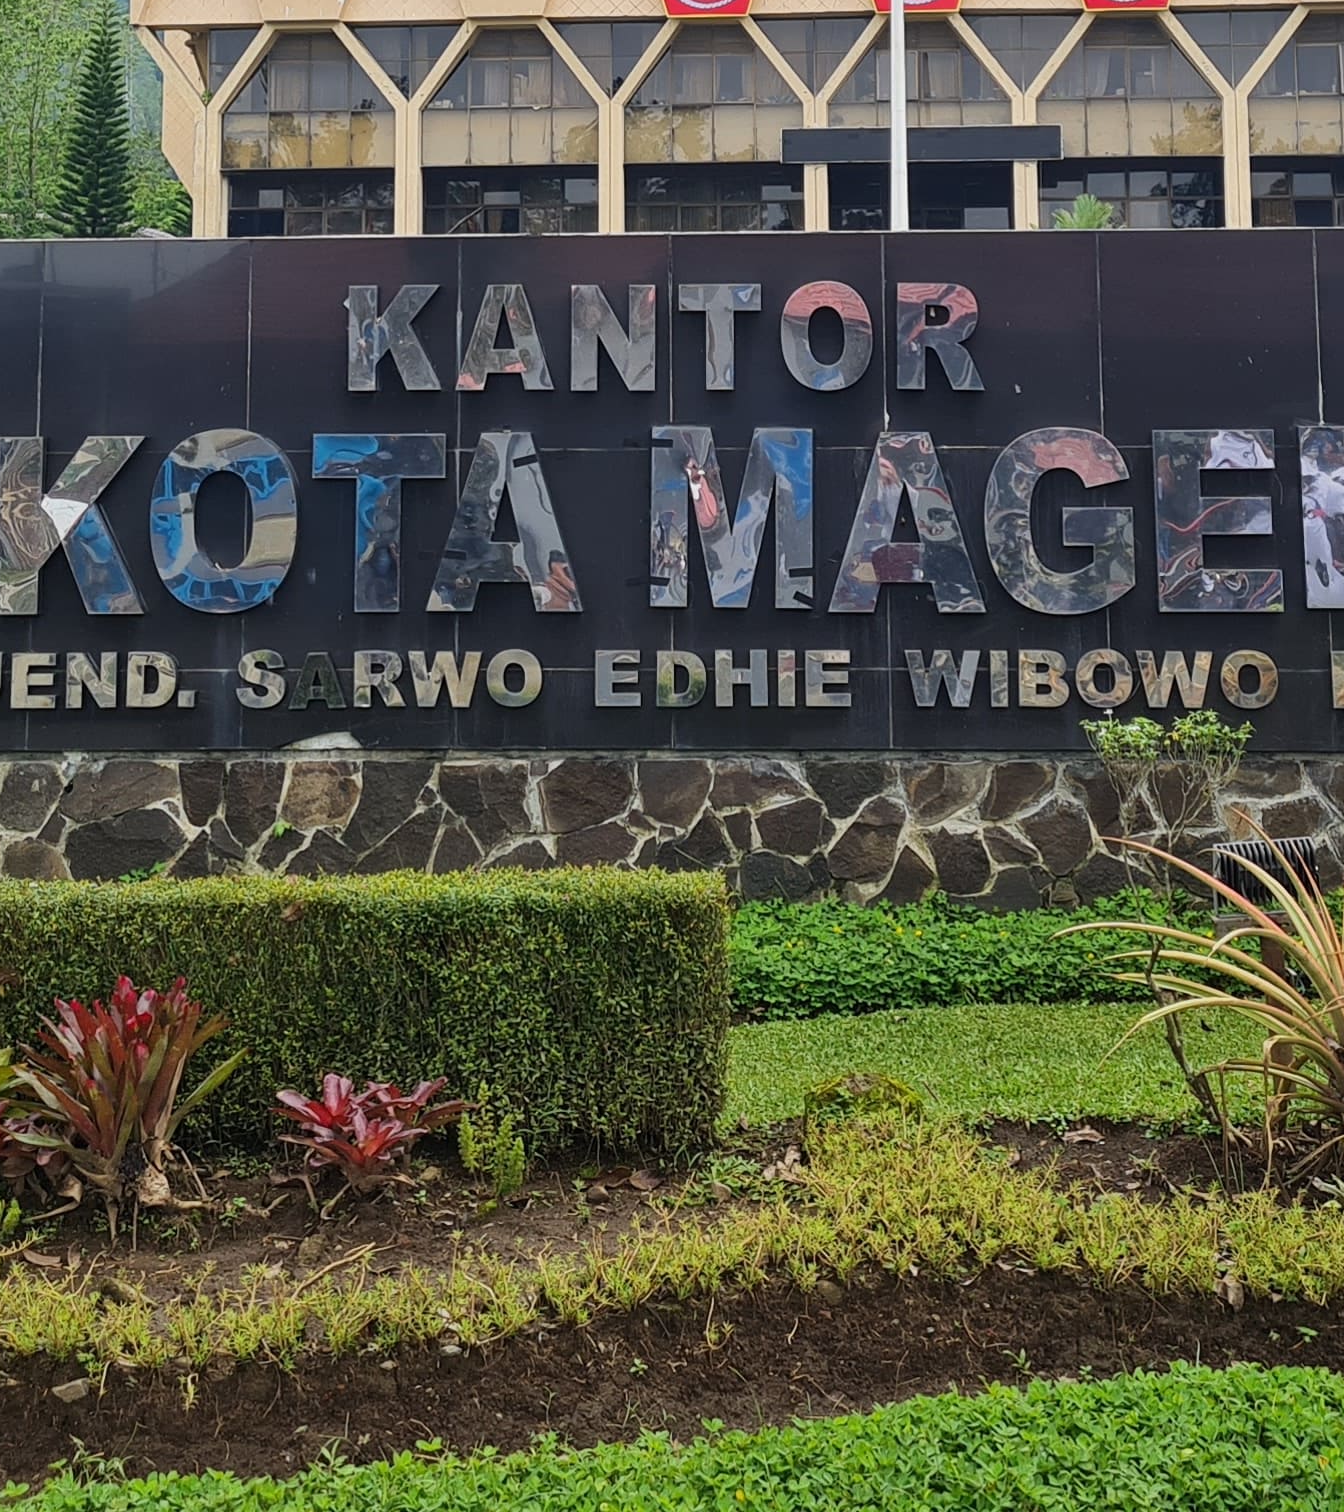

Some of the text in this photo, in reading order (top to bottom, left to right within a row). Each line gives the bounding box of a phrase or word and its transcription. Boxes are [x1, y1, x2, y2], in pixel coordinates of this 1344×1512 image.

[346, 280, 985, 391] KANTOR
[236, 649, 544, 709] SARWO
[594, 649, 852, 708] EDHIE
[905, 648, 1279, 709] WIBOWO
